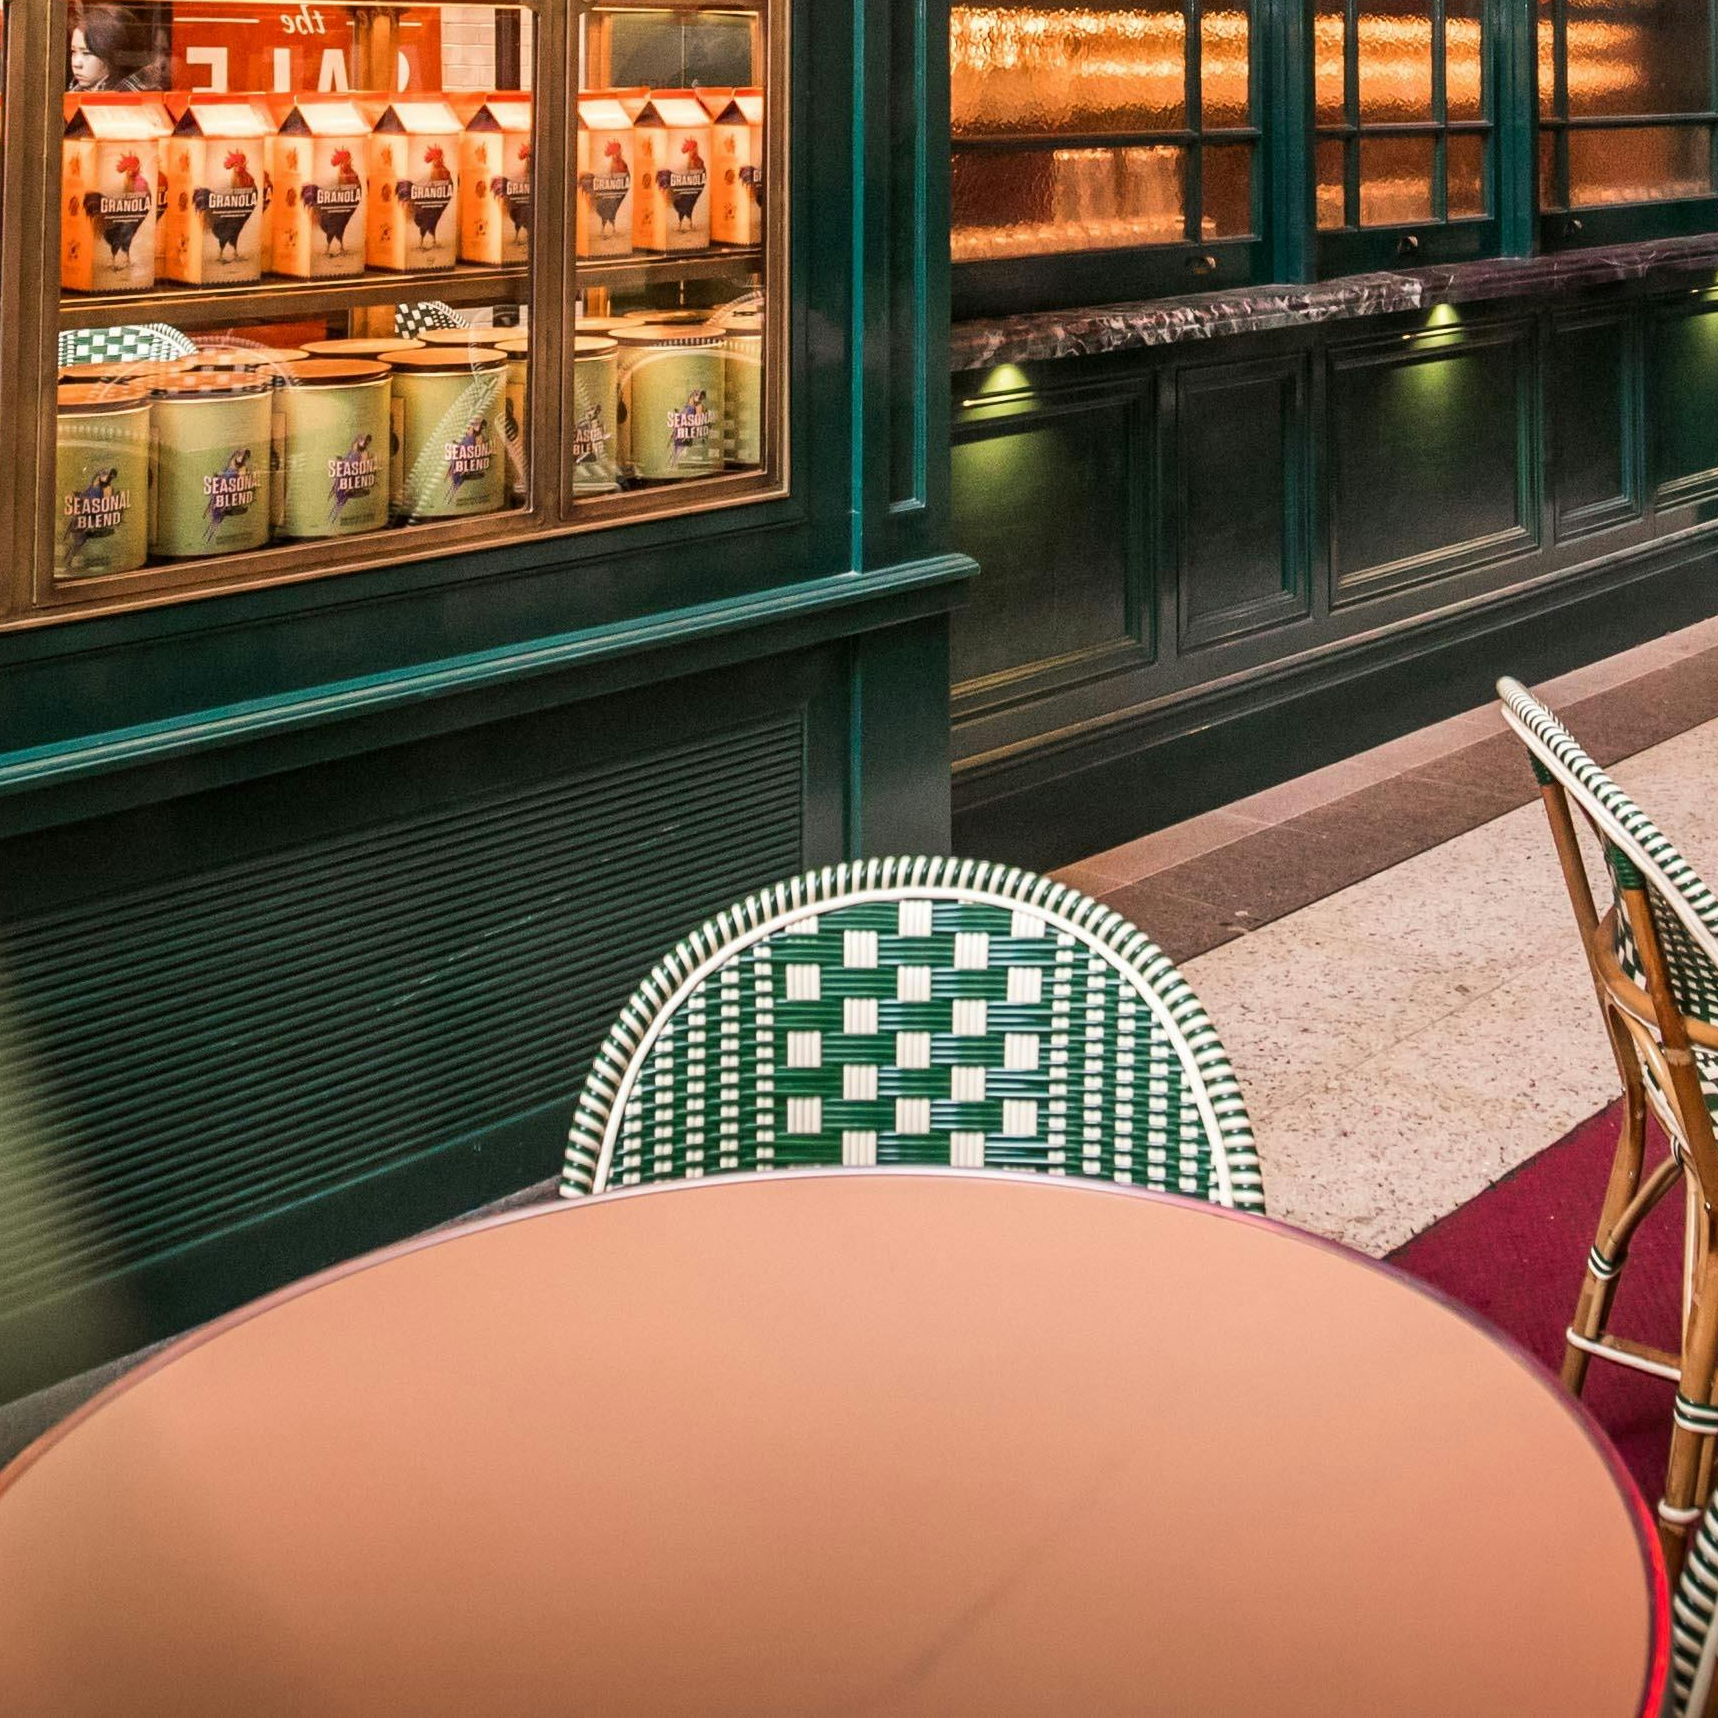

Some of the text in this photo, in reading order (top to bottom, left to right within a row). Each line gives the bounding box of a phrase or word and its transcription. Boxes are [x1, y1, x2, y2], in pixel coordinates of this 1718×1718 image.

[593, 176, 631, 191] GRANOLA
[670, 172, 707, 187] GRANOLA
[316, 188, 362, 204] GRANOLA
[410, 184, 453, 200] GRANOLA
[506, 181, 531, 196] GRAN
[100, 196, 151, 213] GRANOLA
[208, 191, 258, 209] GRANOLA
[667, 410, 716, 428] SEASON
[676, 424, 709, 439] BLEND
[454, 457, 490, 473] BLEND
[338, 474, 376, 491] BLEND
[62, 489, 132, 516] SEASONAL
[215, 491, 254, 508] BLEND
[77, 511, 122, 530] BLEND
